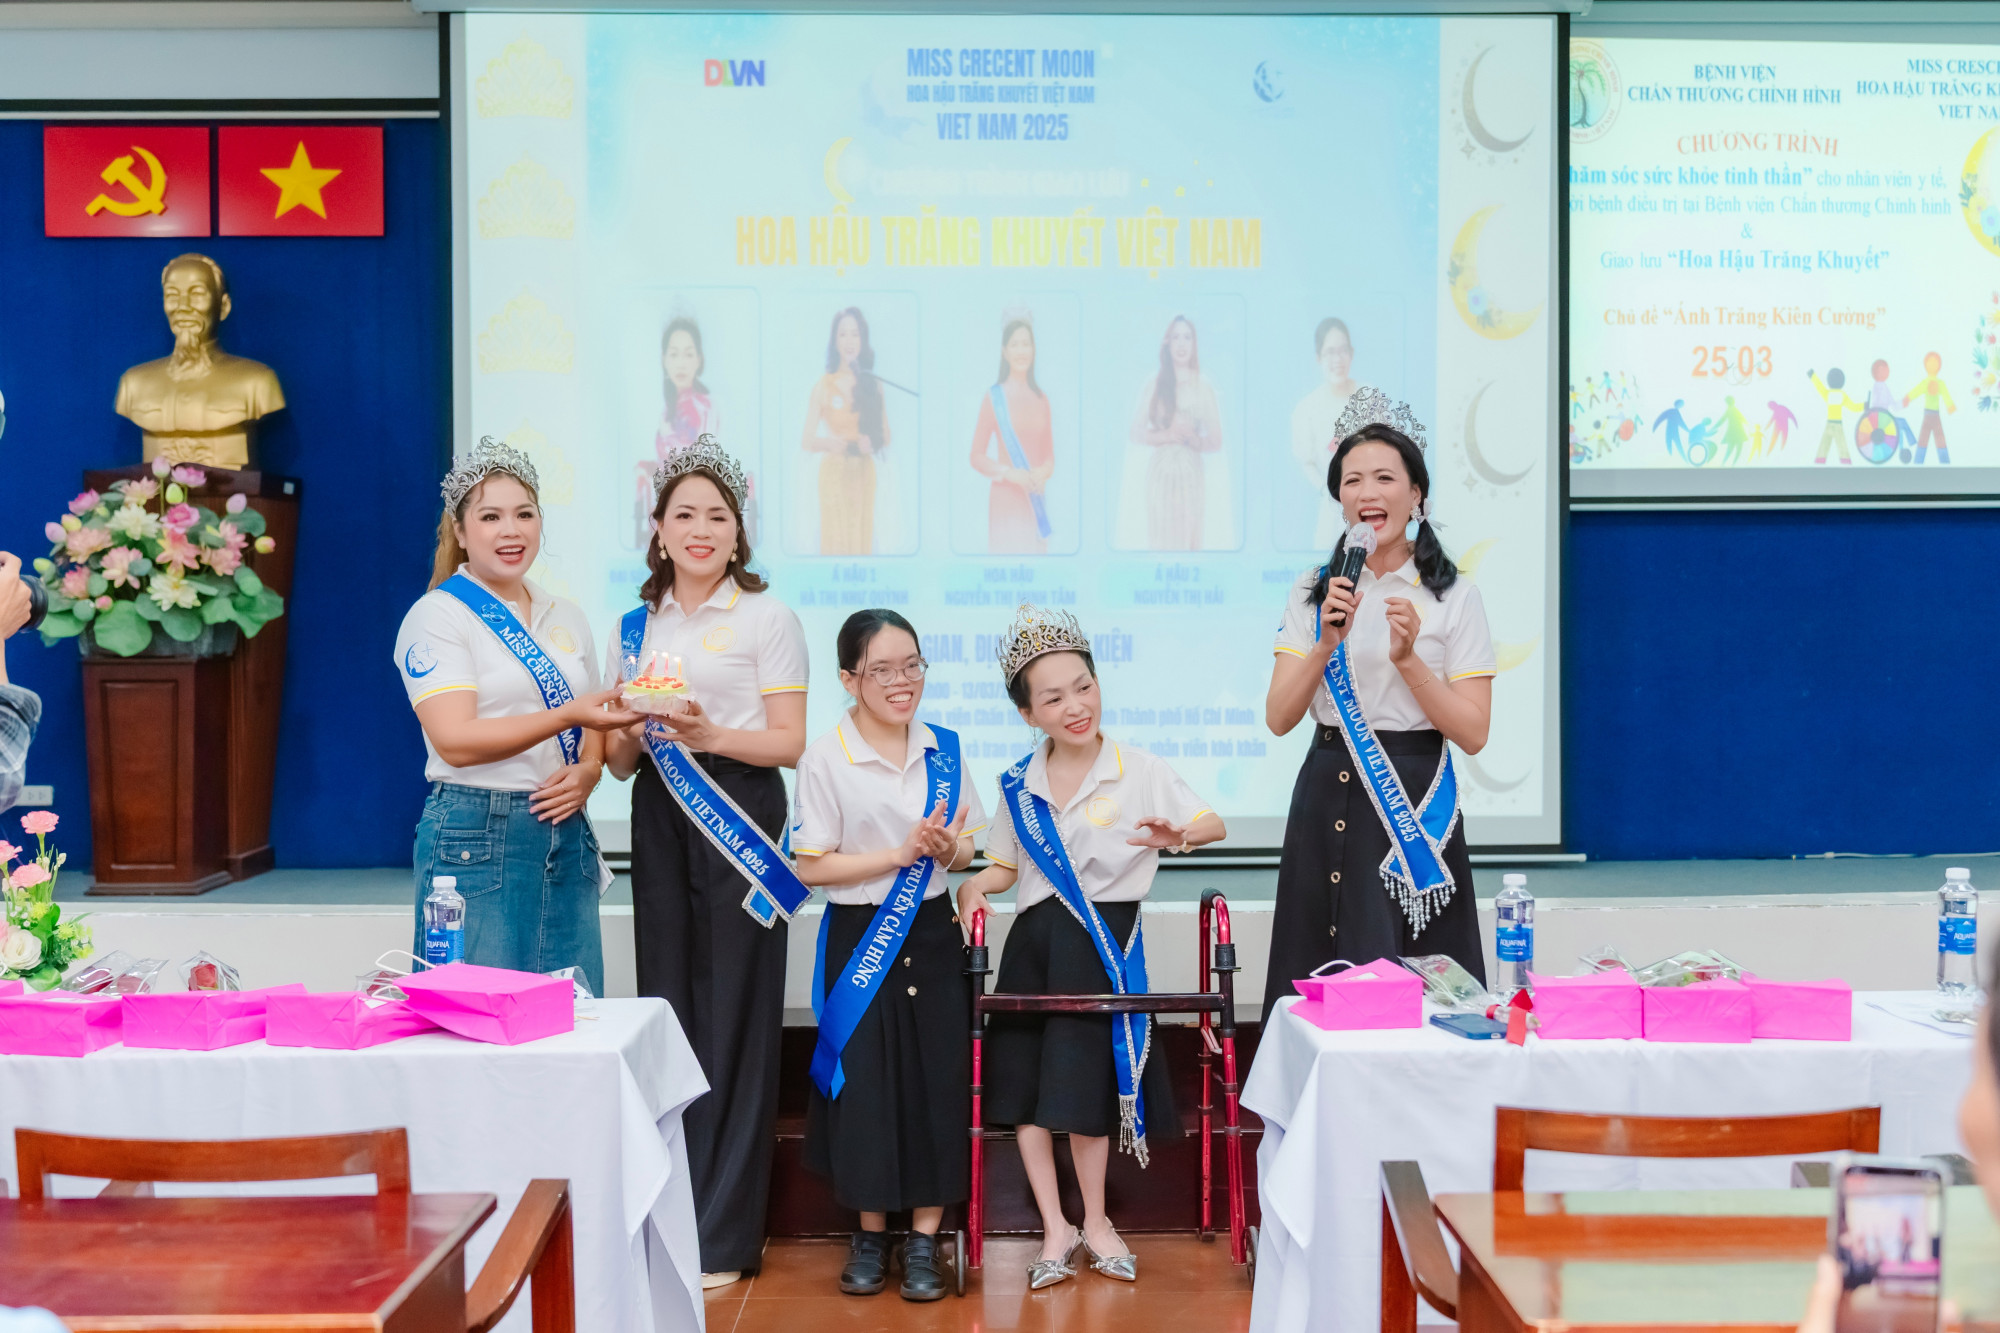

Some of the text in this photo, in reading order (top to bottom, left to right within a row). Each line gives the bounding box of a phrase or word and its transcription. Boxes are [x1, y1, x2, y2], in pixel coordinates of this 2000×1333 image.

[907, 48, 1095, 79] MISS CRECENT MOON
[1694, 64, 1777, 83] BỆNH VIỆN
[1907, 59, 1943, 74] MISS
[906, 84, 930, 103] HOA
[1068, 85, 1095, 104] NAM
[1676, 86, 1744, 103] THƯƠNG
[1857, 80, 1889, 95] HOA
[1893, 79, 1925, 99] HẬU
[1939, 105, 2000, 120] VIET NA
[936, 112, 1069, 141] VIET NAM 2025
[1677, 130, 1768, 155] CHƯƠNG
[1612, 165, 1639, 185] sóc
[1643, 165, 1673, 185] sức
[1725, 166, 1759, 185] tinh
[1816, 169, 1842, 187] cho
[1917, 175, 1927, 191] y
[1705, 195, 1741, 214] Bệnh
[736, 204, 1262, 278] HOA HẬU TRĂNG KHUYẾT VIỆT NAM
[1741, 223, 1754, 239] &
[1600, 251, 1634, 270] Giao
[1640, 251, 1663, 269] lưu
[1719, 248, 1755, 273] Hậu
[1760, 249, 1812, 273] Trăng
[1604, 306, 1637, 325] Chủ
[1715, 305, 1767, 329] Trăng
[516, 631, 538, 655] 2ND
[499, 626, 529, 657] MISS
[526, 657, 562, 709] CRESCE
[1364, 743, 1405, 812] VIETNAM
[1394, 810, 1422, 842] 2025
[660, 754, 694, 797] MOON
[690, 793, 746, 853] VIETNAM
[739, 847, 770, 876] 2025
